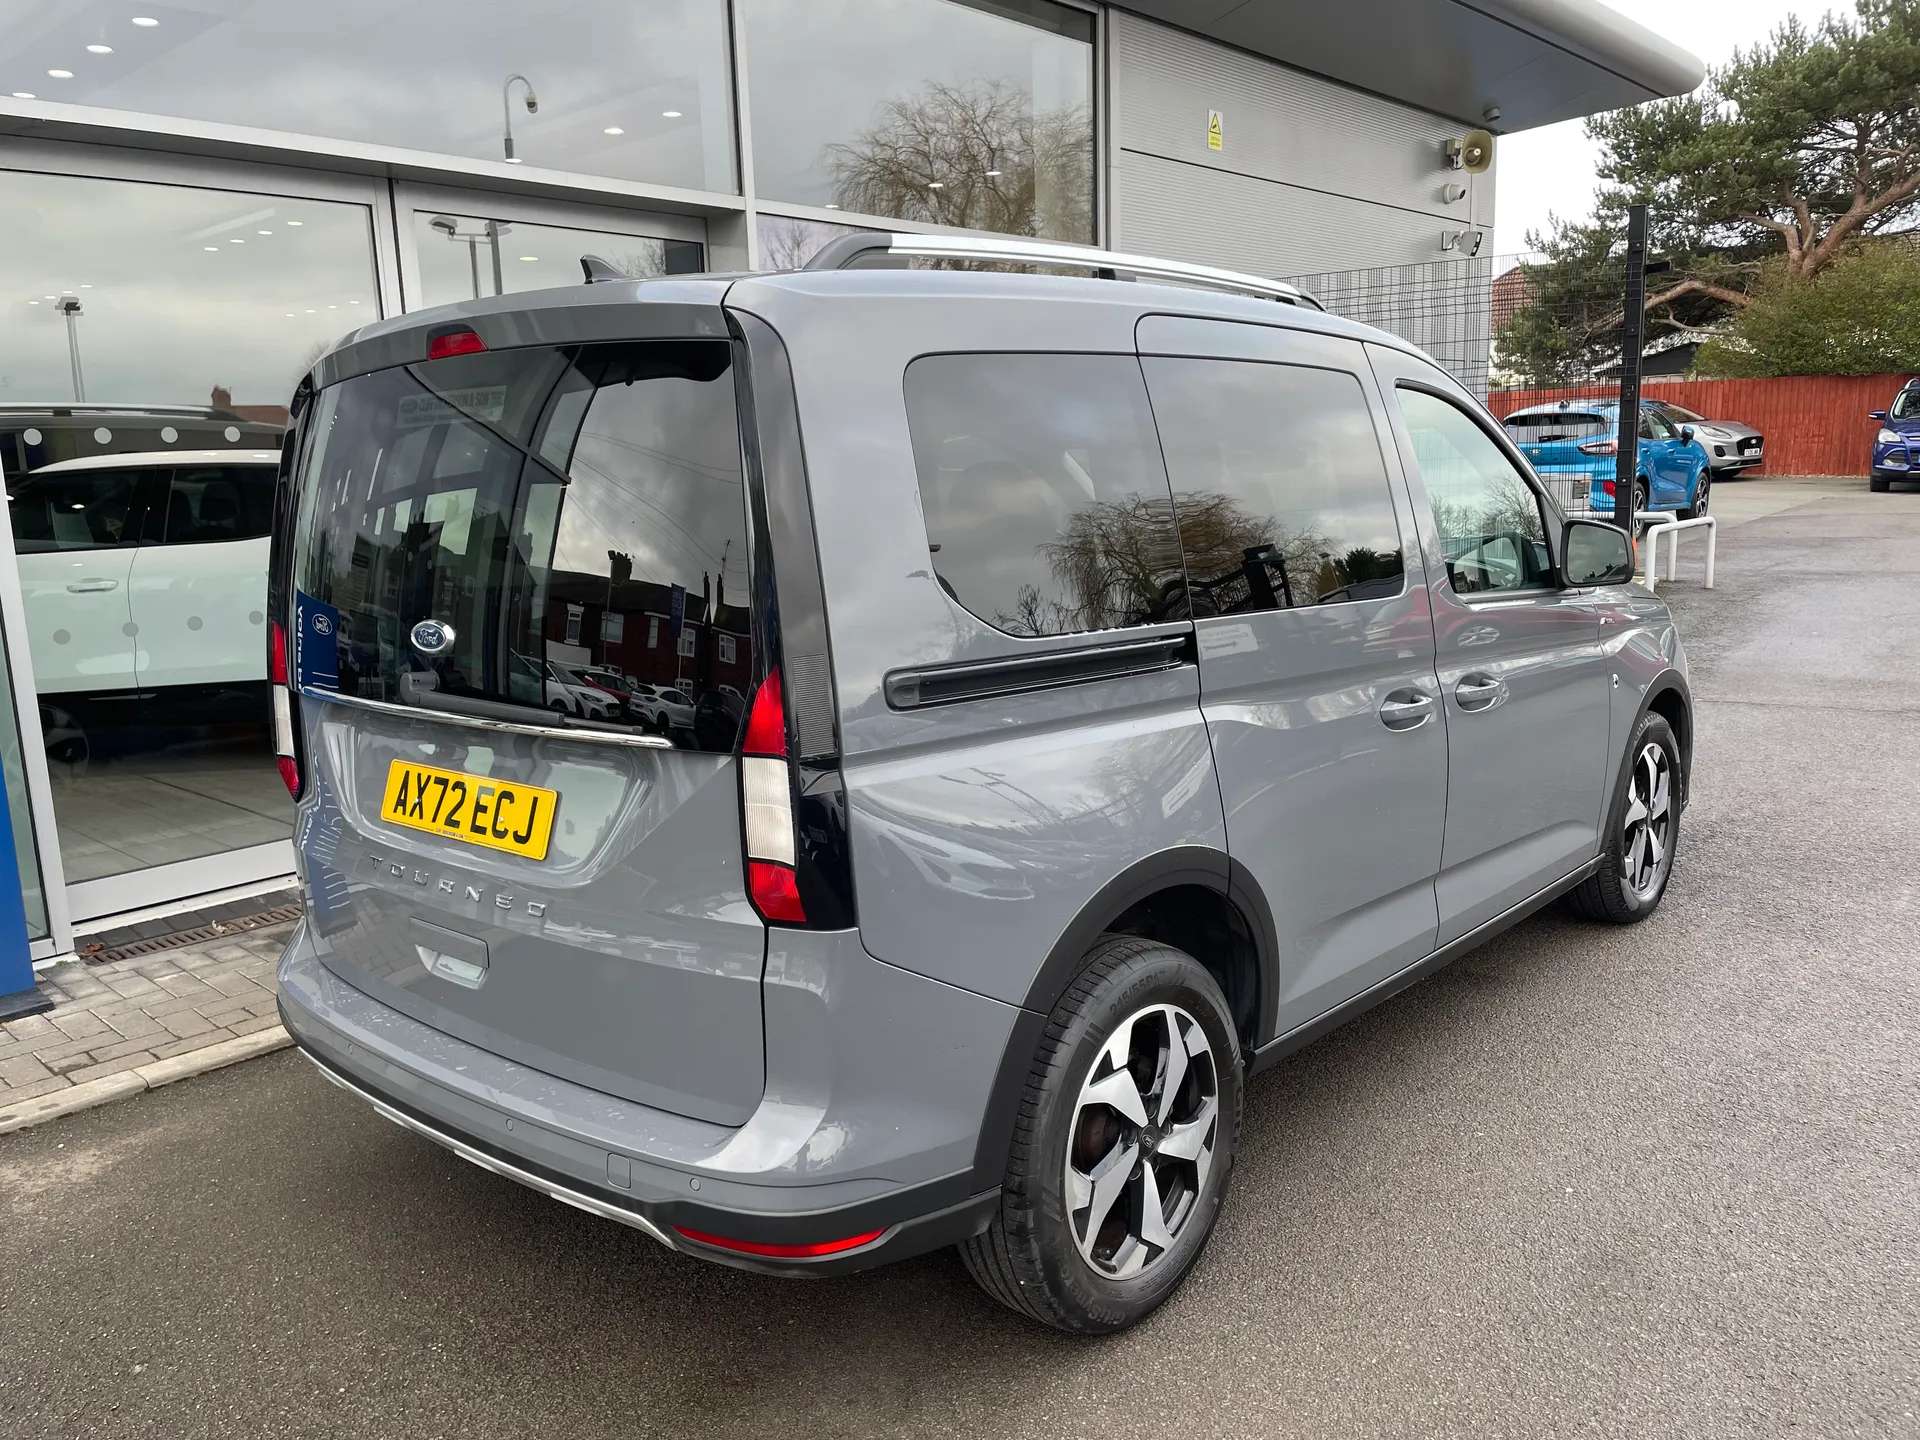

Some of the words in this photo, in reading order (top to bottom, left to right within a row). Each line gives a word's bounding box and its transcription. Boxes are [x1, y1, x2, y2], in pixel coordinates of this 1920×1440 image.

[393, 770, 467, 829] AX72
[470, 785, 539, 845] ECJ
[369, 854, 547, 918] TOURNEO
